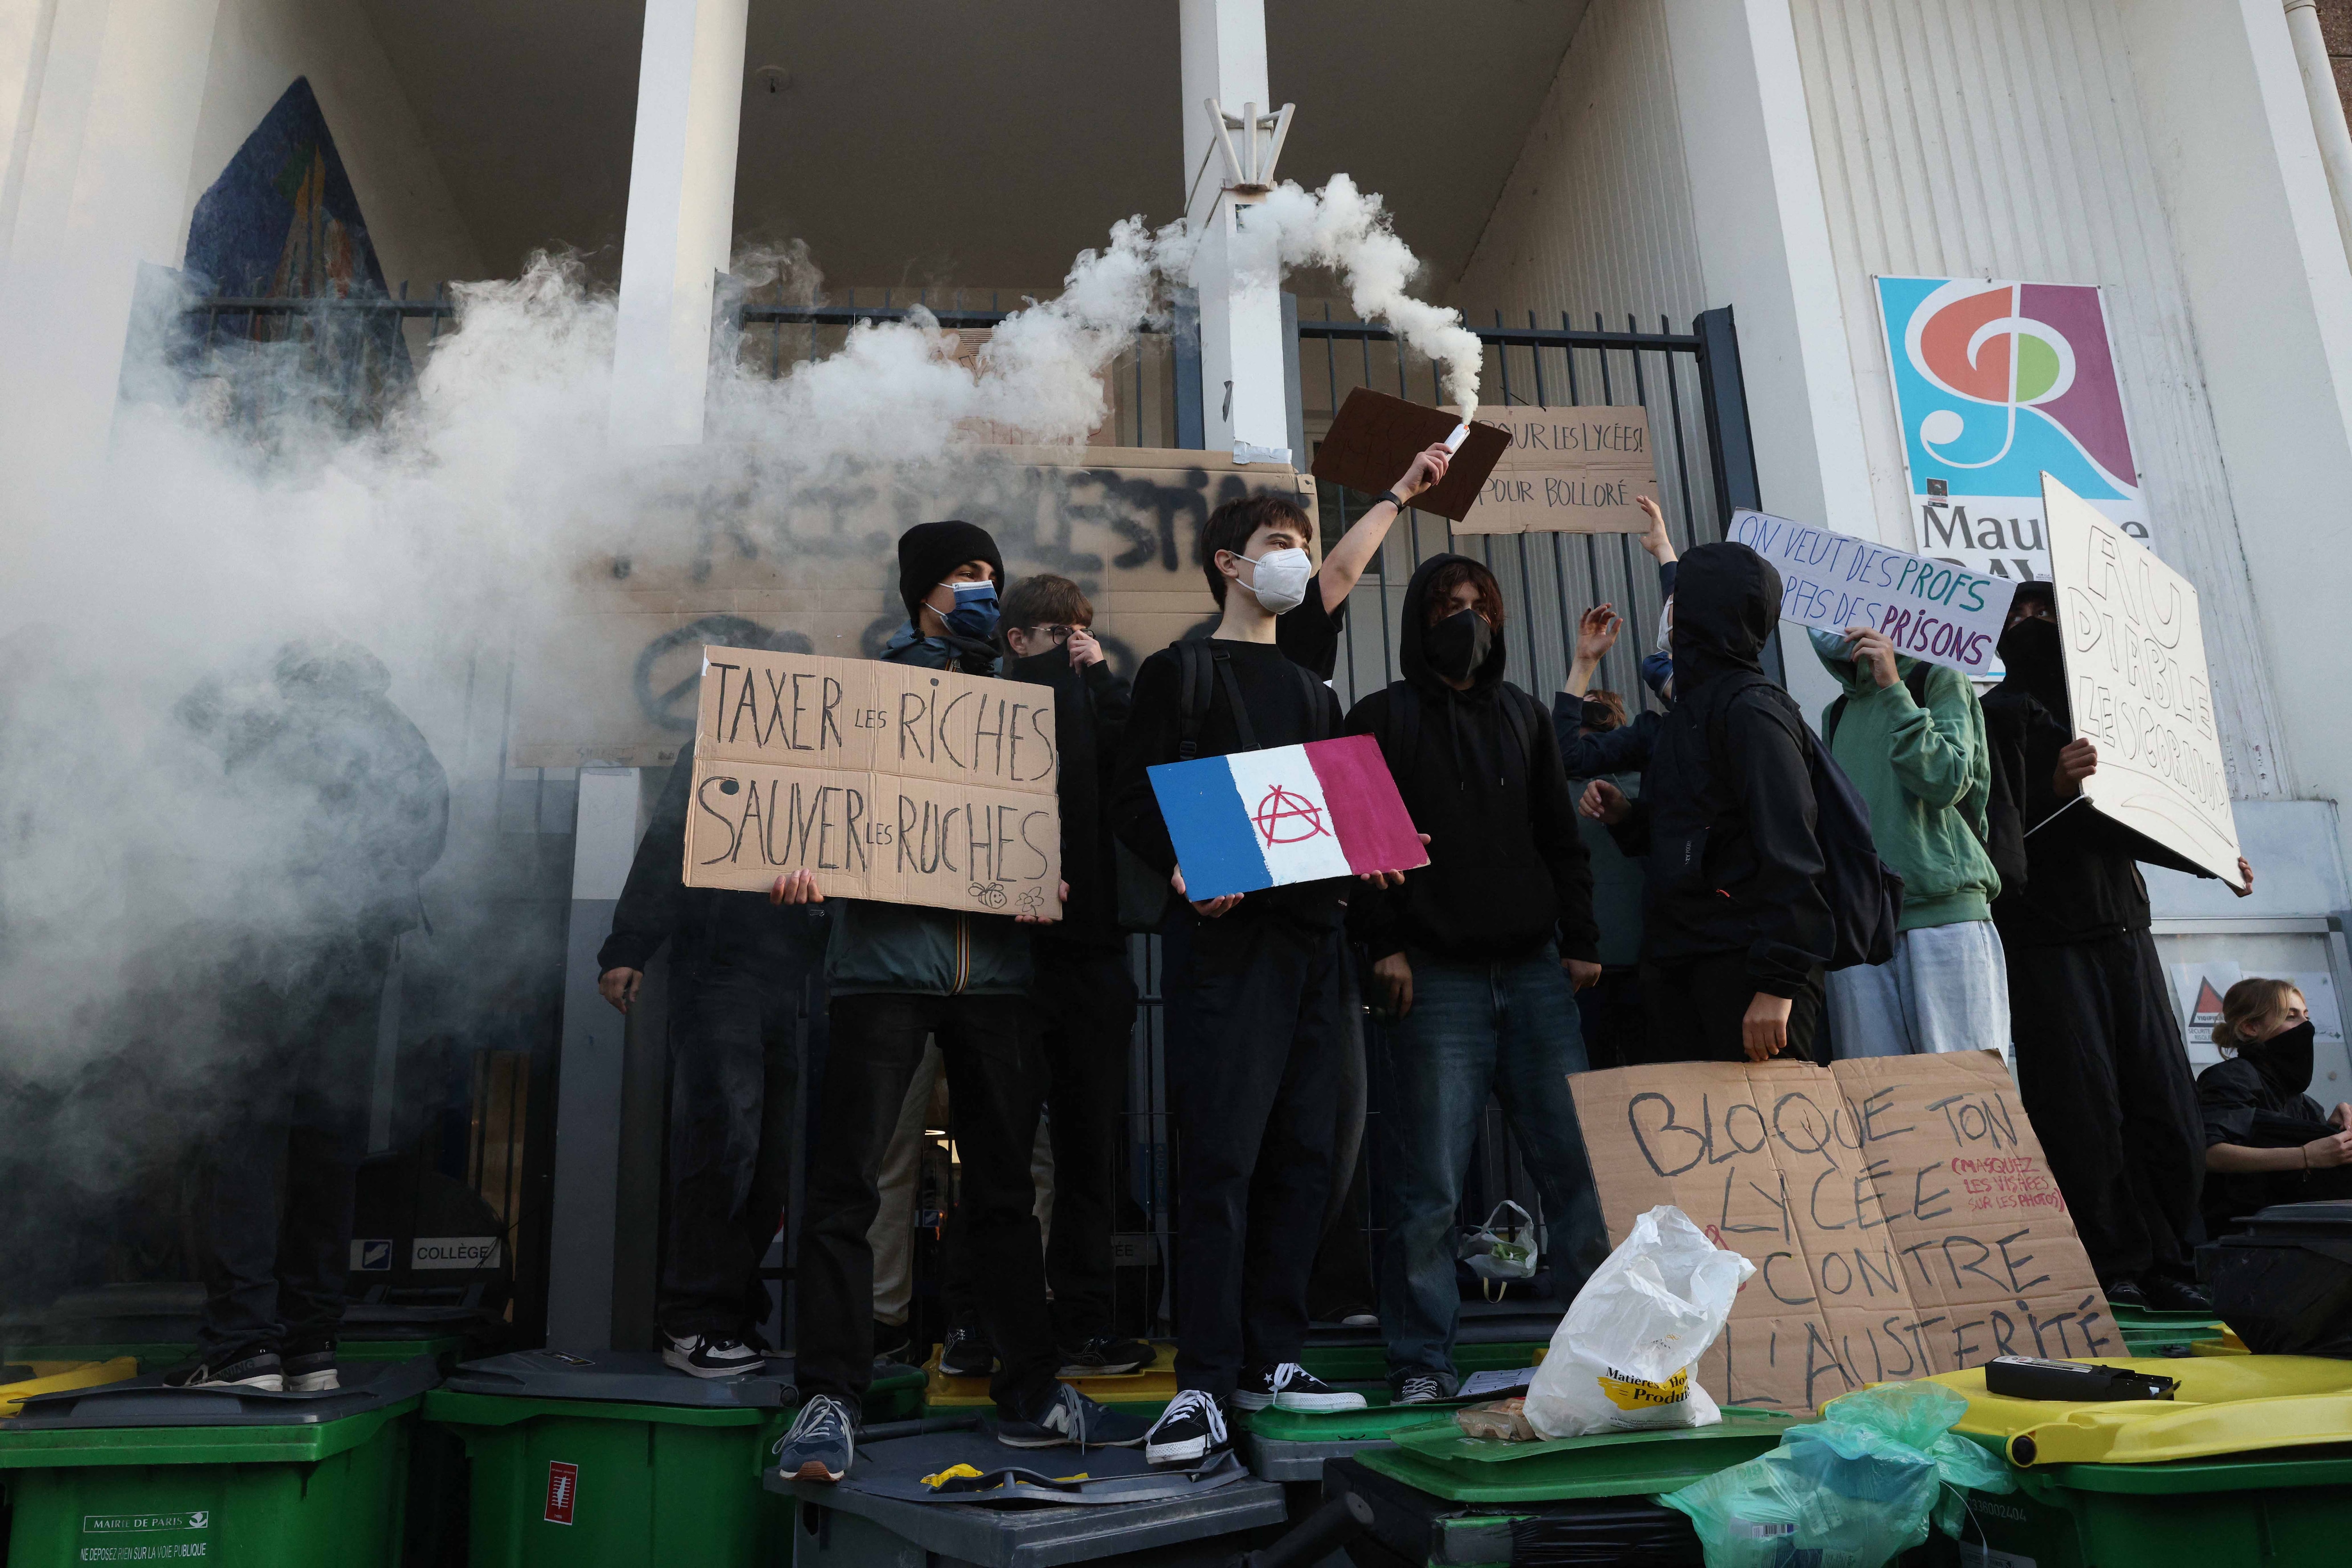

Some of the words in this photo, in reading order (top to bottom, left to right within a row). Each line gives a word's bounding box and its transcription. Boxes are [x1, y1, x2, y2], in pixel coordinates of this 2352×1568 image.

[1553, 426, 1580, 450] LES
[1545, 477, 1630, 508] BOLLORÉ
[1739, 516, 1781, 553] ON
[1784, 527, 1849, 573] VEUT
[1848, 545, 1899, 588] DES
[1896, 558, 1991, 612] PROFS
[2087, 525, 2181, 649] AU
[1781, 576, 1834, 619] PAS
[1833, 592, 1882, 629] DES
[2067, 587, 2212, 740] DIABLE
[710, 662, 843, 750] TAXER
[854, 708, 887, 729] LES
[698, 776, 866, 873] SAUVER
[866, 822, 892, 845] LES
[898, 795, 1049, 883] RUCHES
[1628, 1083, 1917, 1178] BLOQUE
[1925, 1088, 2018, 1150] TON
[1722, 1159, 1952, 1246] LYCÉE
[1963, 1178, 1992, 1194] LES
[1993, 1173, 2049, 1193] VISAGES
[1968, 1195, 1993, 1212] SUR
[1995, 1194, 2017, 1209] LES
[417, 1242, 490, 1260] COLLÈGE
[1763, 1227, 2052, 1306] CONTRE
[1606, 1366, 1660, 1389] Matières
[94, 1519, 130, 1528] MAIRIE
[134, 1519, 148, 1528] DE
[152, 1517, 183, 1526] PARIS
[80, 1547, 88, 1560] NE
[89, 1547, 117, 1561] DEPOSEZ
[118, 1547, 132, 1560] RIEN
[133, 1546, 147, 1560] SUR
[148, 1546, 156, 1559] LA
[157, 1545, 173, 1558] VOIE
[174, 1543, 207, 1557] PUBLIQUE
